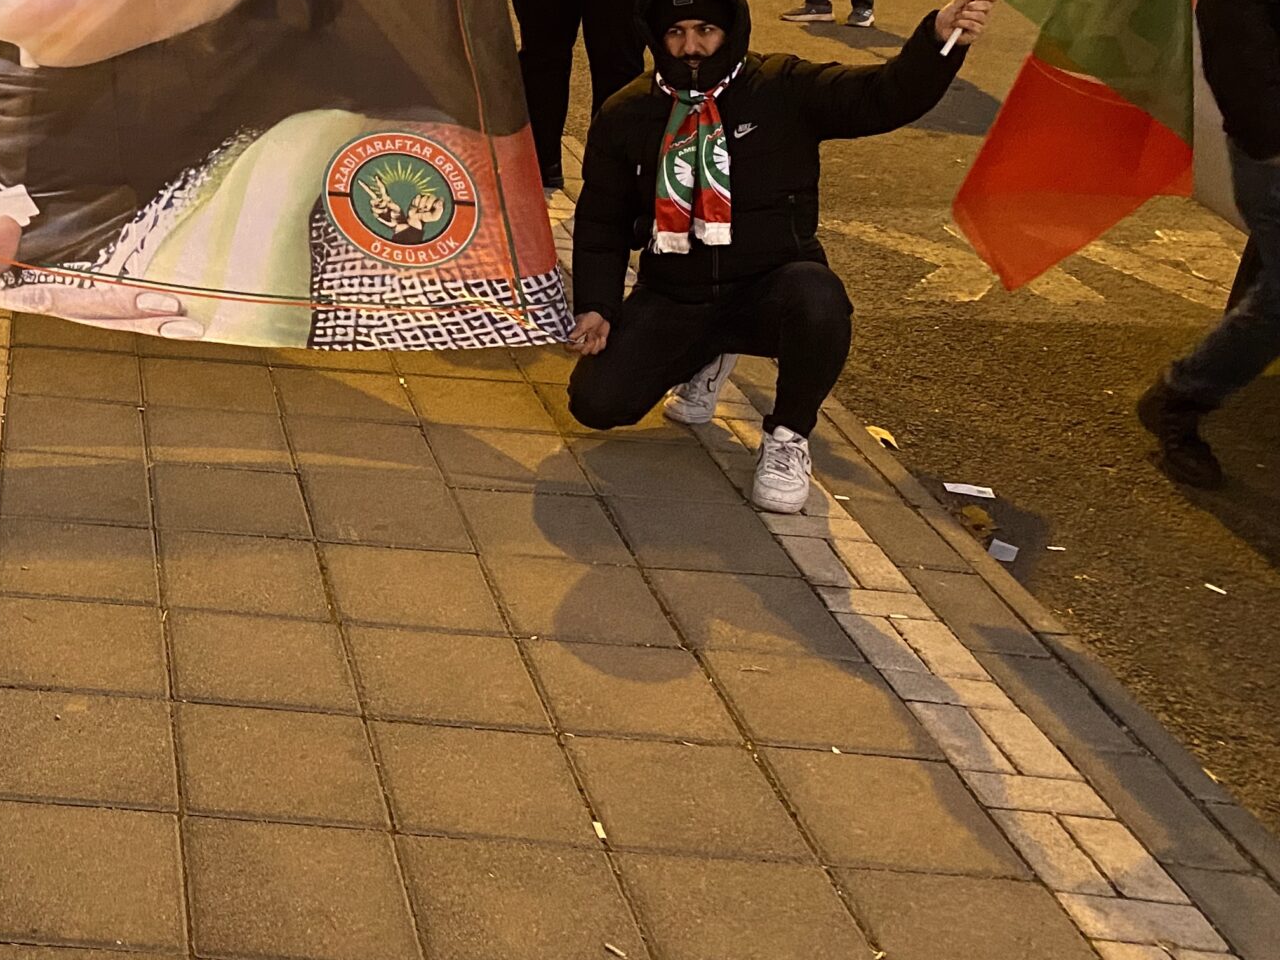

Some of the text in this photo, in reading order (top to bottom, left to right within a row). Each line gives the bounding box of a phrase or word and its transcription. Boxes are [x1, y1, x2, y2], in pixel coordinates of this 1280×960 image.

[355, 139, 433, 159] TARAFTAR
[434, 155, 470, 201] GRUBU
[370, 236, 460, 263] ÖZGÜRLÜK
